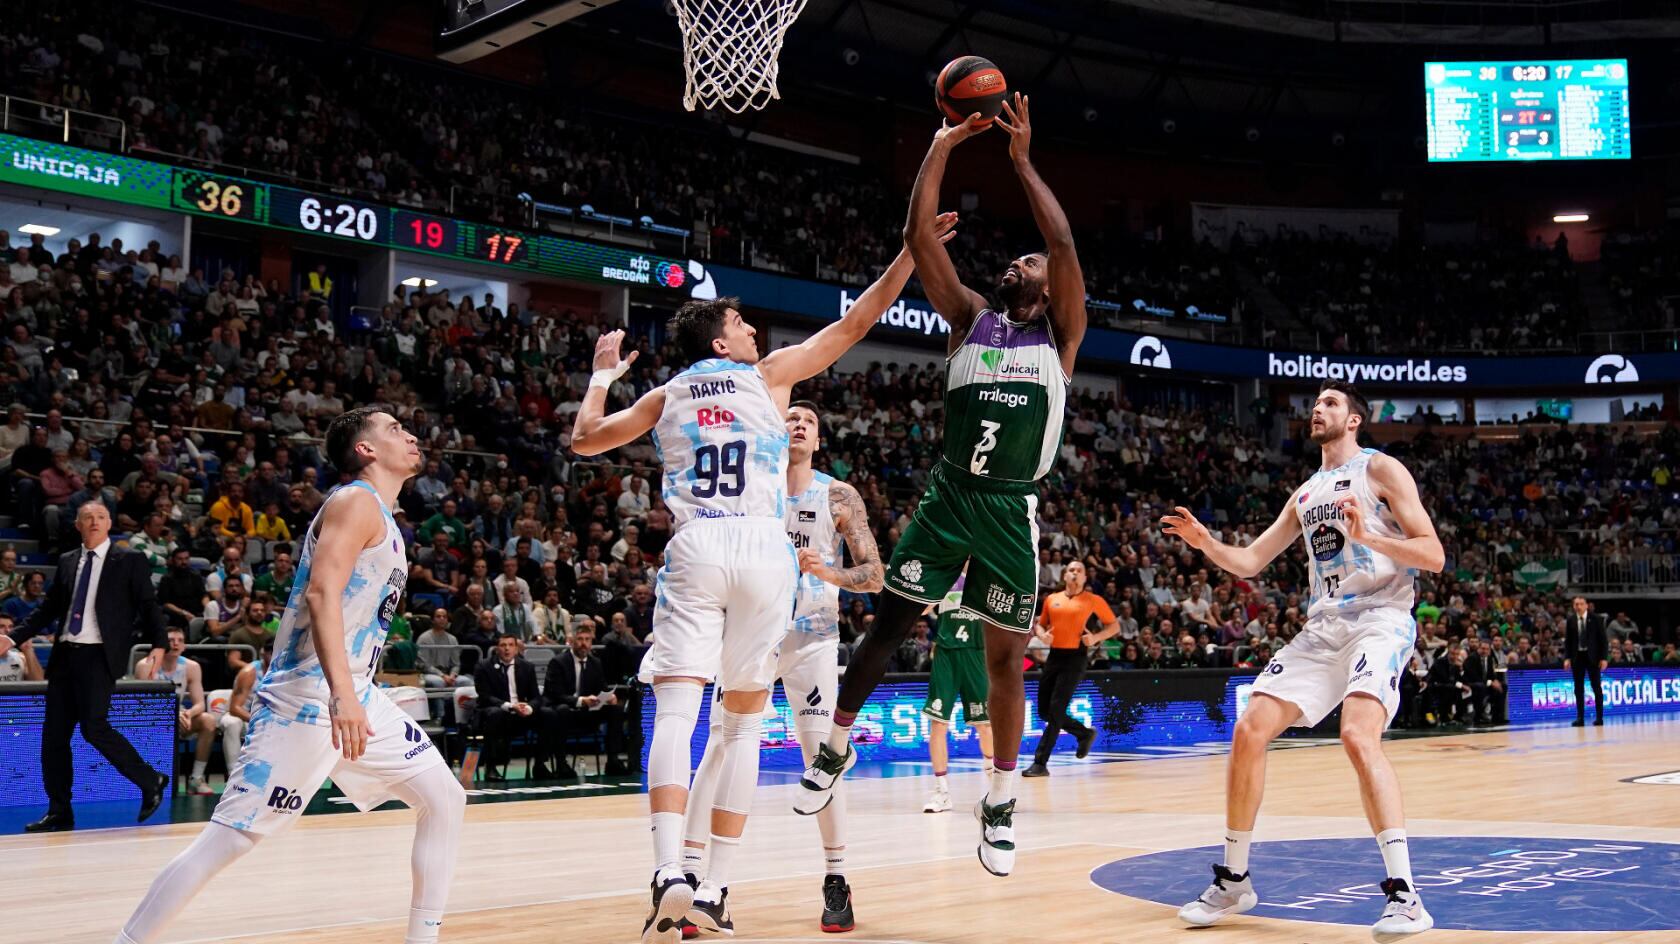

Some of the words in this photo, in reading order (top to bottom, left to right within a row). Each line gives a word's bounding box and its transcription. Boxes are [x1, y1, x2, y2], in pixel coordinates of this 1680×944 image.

[1512, 65, 1547, 81] 6:20
[1555, 65, 1573, 80] 17
[1537, 131, 1549, 146] 3
[13, 151, 119, 186] UNICAJA
[197, 181, 243, 216] 36
[300, 198, 377, 240] 6:20
[410, 219, 443, 248] 19
[487, 234, 522, 263] 17
[630, 256, 650, 271] RÍO
[1001, 363, 1039, 376] Unicaja
[1269, 353, 1467, 383] holidayworld.es
[689, 376, 736, 399] NAKIĆ
[697, 405, 735, 427] Río
[691, 440, 746, 498] 99
[955, 625, 969, 642] 4
[1263, 658, 1284, 675] ío
[267, 786, 303, 810] Río
